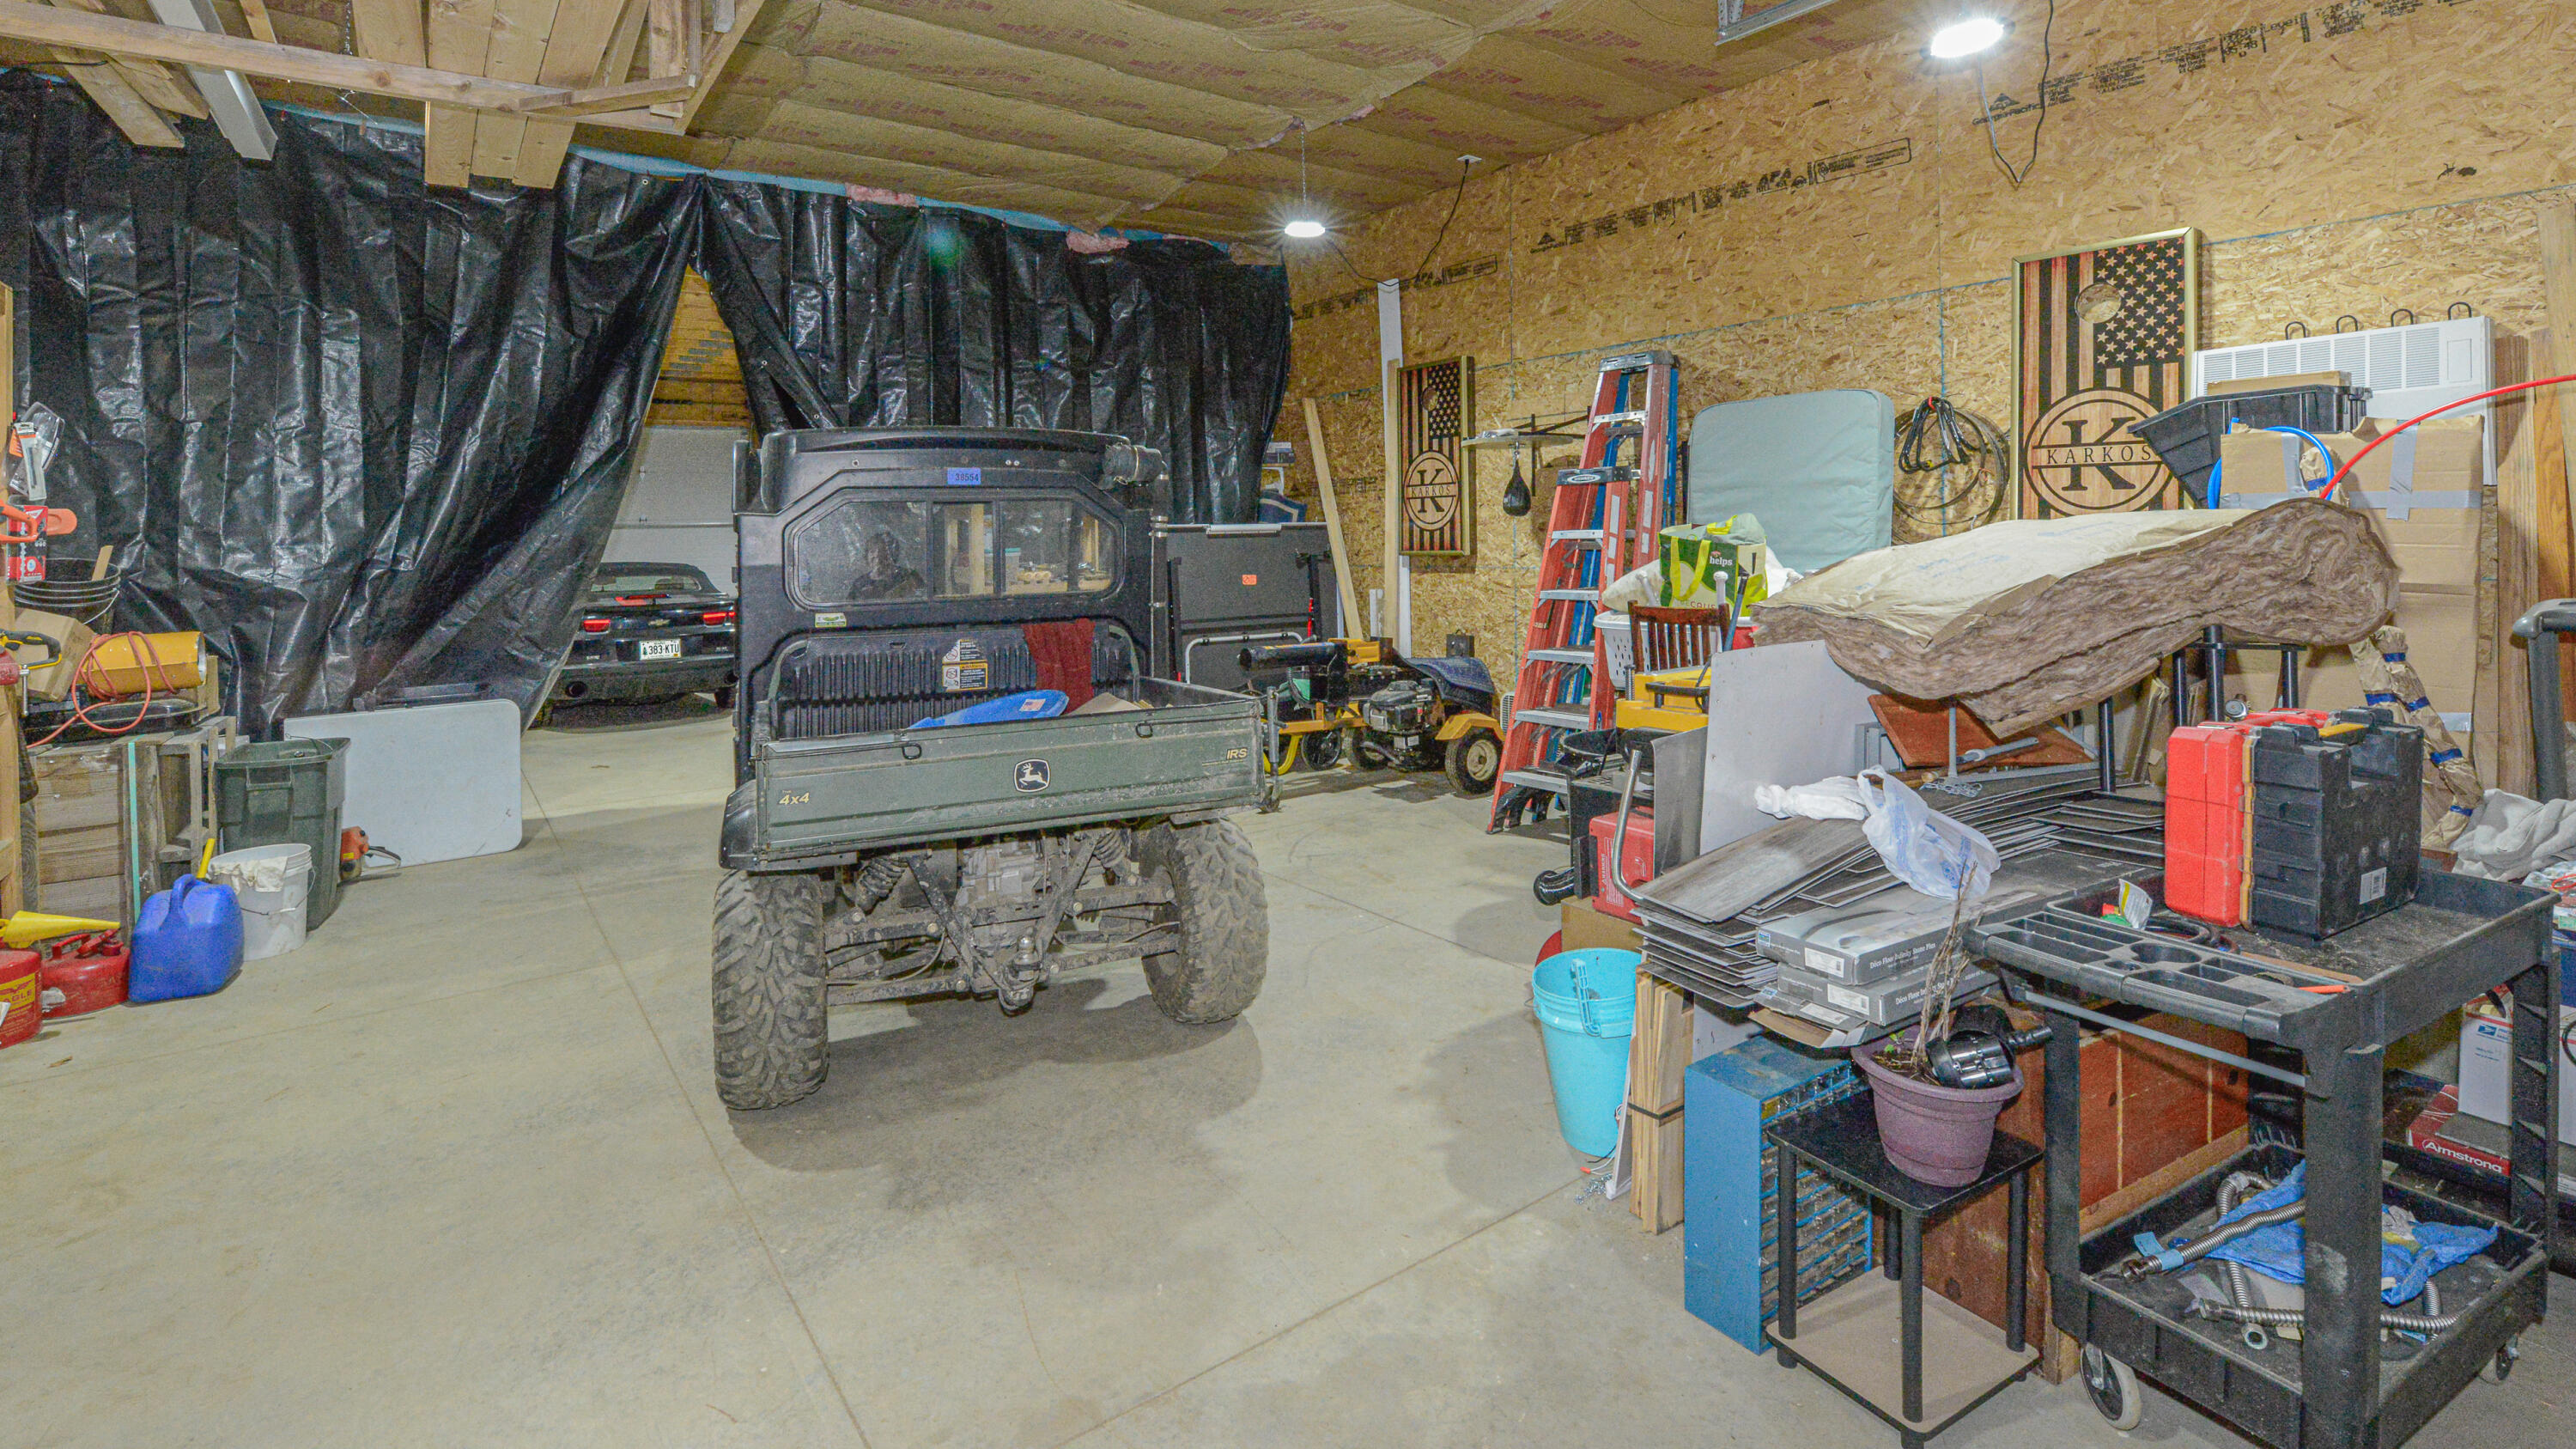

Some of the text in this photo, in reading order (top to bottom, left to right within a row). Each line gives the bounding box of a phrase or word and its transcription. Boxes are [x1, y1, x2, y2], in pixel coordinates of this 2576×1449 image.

[2046, 444, 2152, 465] KARKOS
[1411, 484, 1451, 498] KARKOS
[1709, 556, 1733, 567] helps
[648, 643, 679, 654] 383-KTU
[1226, 747, 1248, 760] IRS
[779, 792, 810, 805] 4x4
